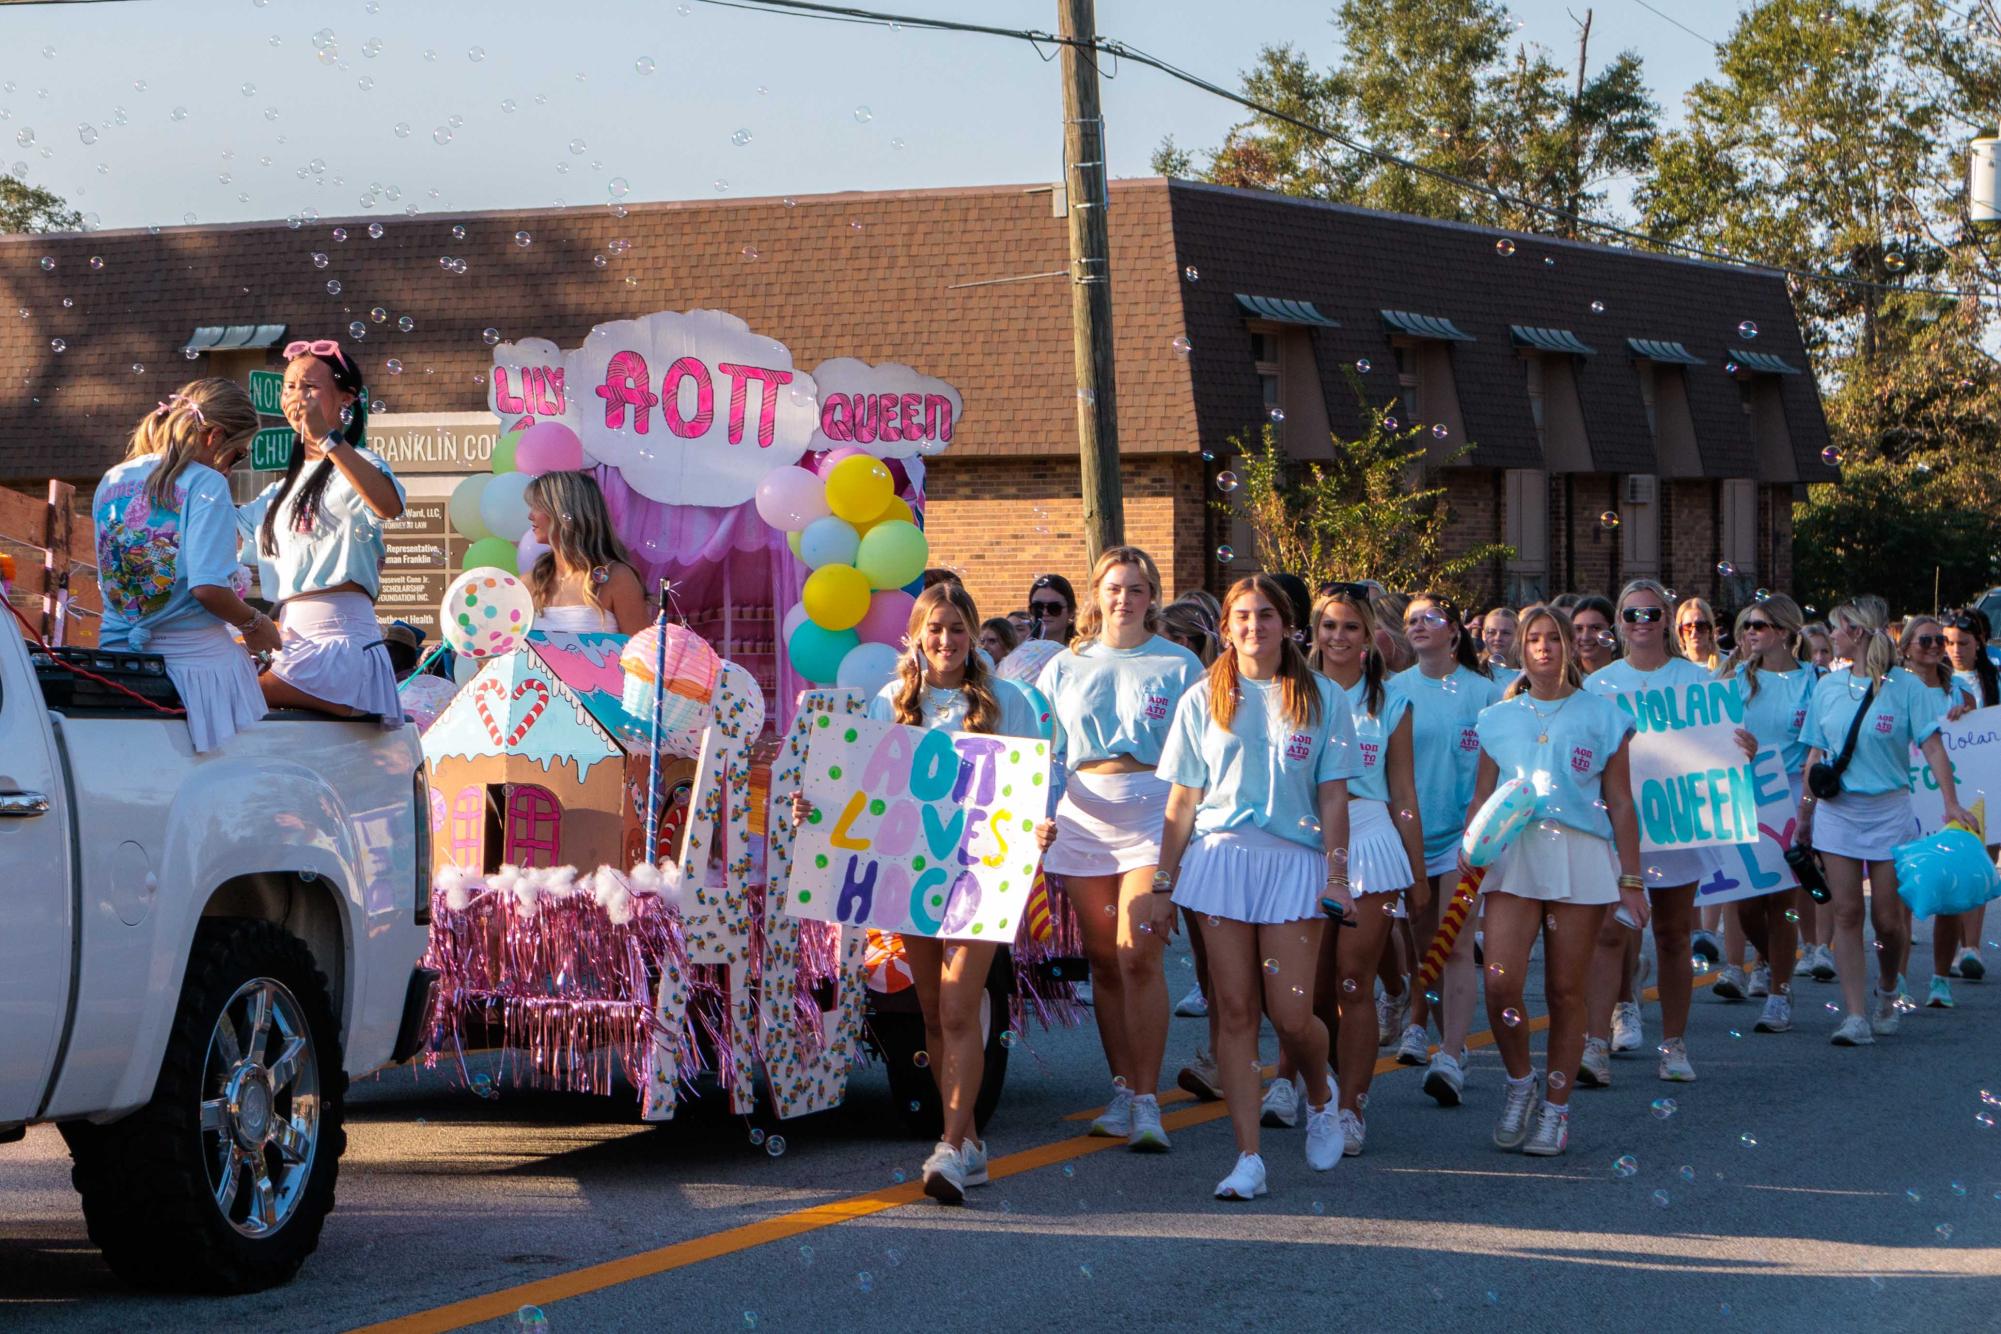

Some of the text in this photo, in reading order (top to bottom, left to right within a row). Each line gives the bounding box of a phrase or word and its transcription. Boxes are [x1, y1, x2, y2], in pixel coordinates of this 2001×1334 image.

[494, 365, 565, 416] LILY
[821, 392, 953, 444] QUEEN
[254, 433, 296, 466] CHU
[415, 521, 428, 529] LAW
[403, 554, 431, 564] Franklin
[382, 584, 425, 593] SCHOLARSHIP
[409, 614, 434, 625] Health
[1616, 680, 1744, 734] NOLAN
[830, 790, 1012, 869] LOVES
[1641, 763, 1757, 846] QUEEN
[836, 854, 982, 936] HOCO
